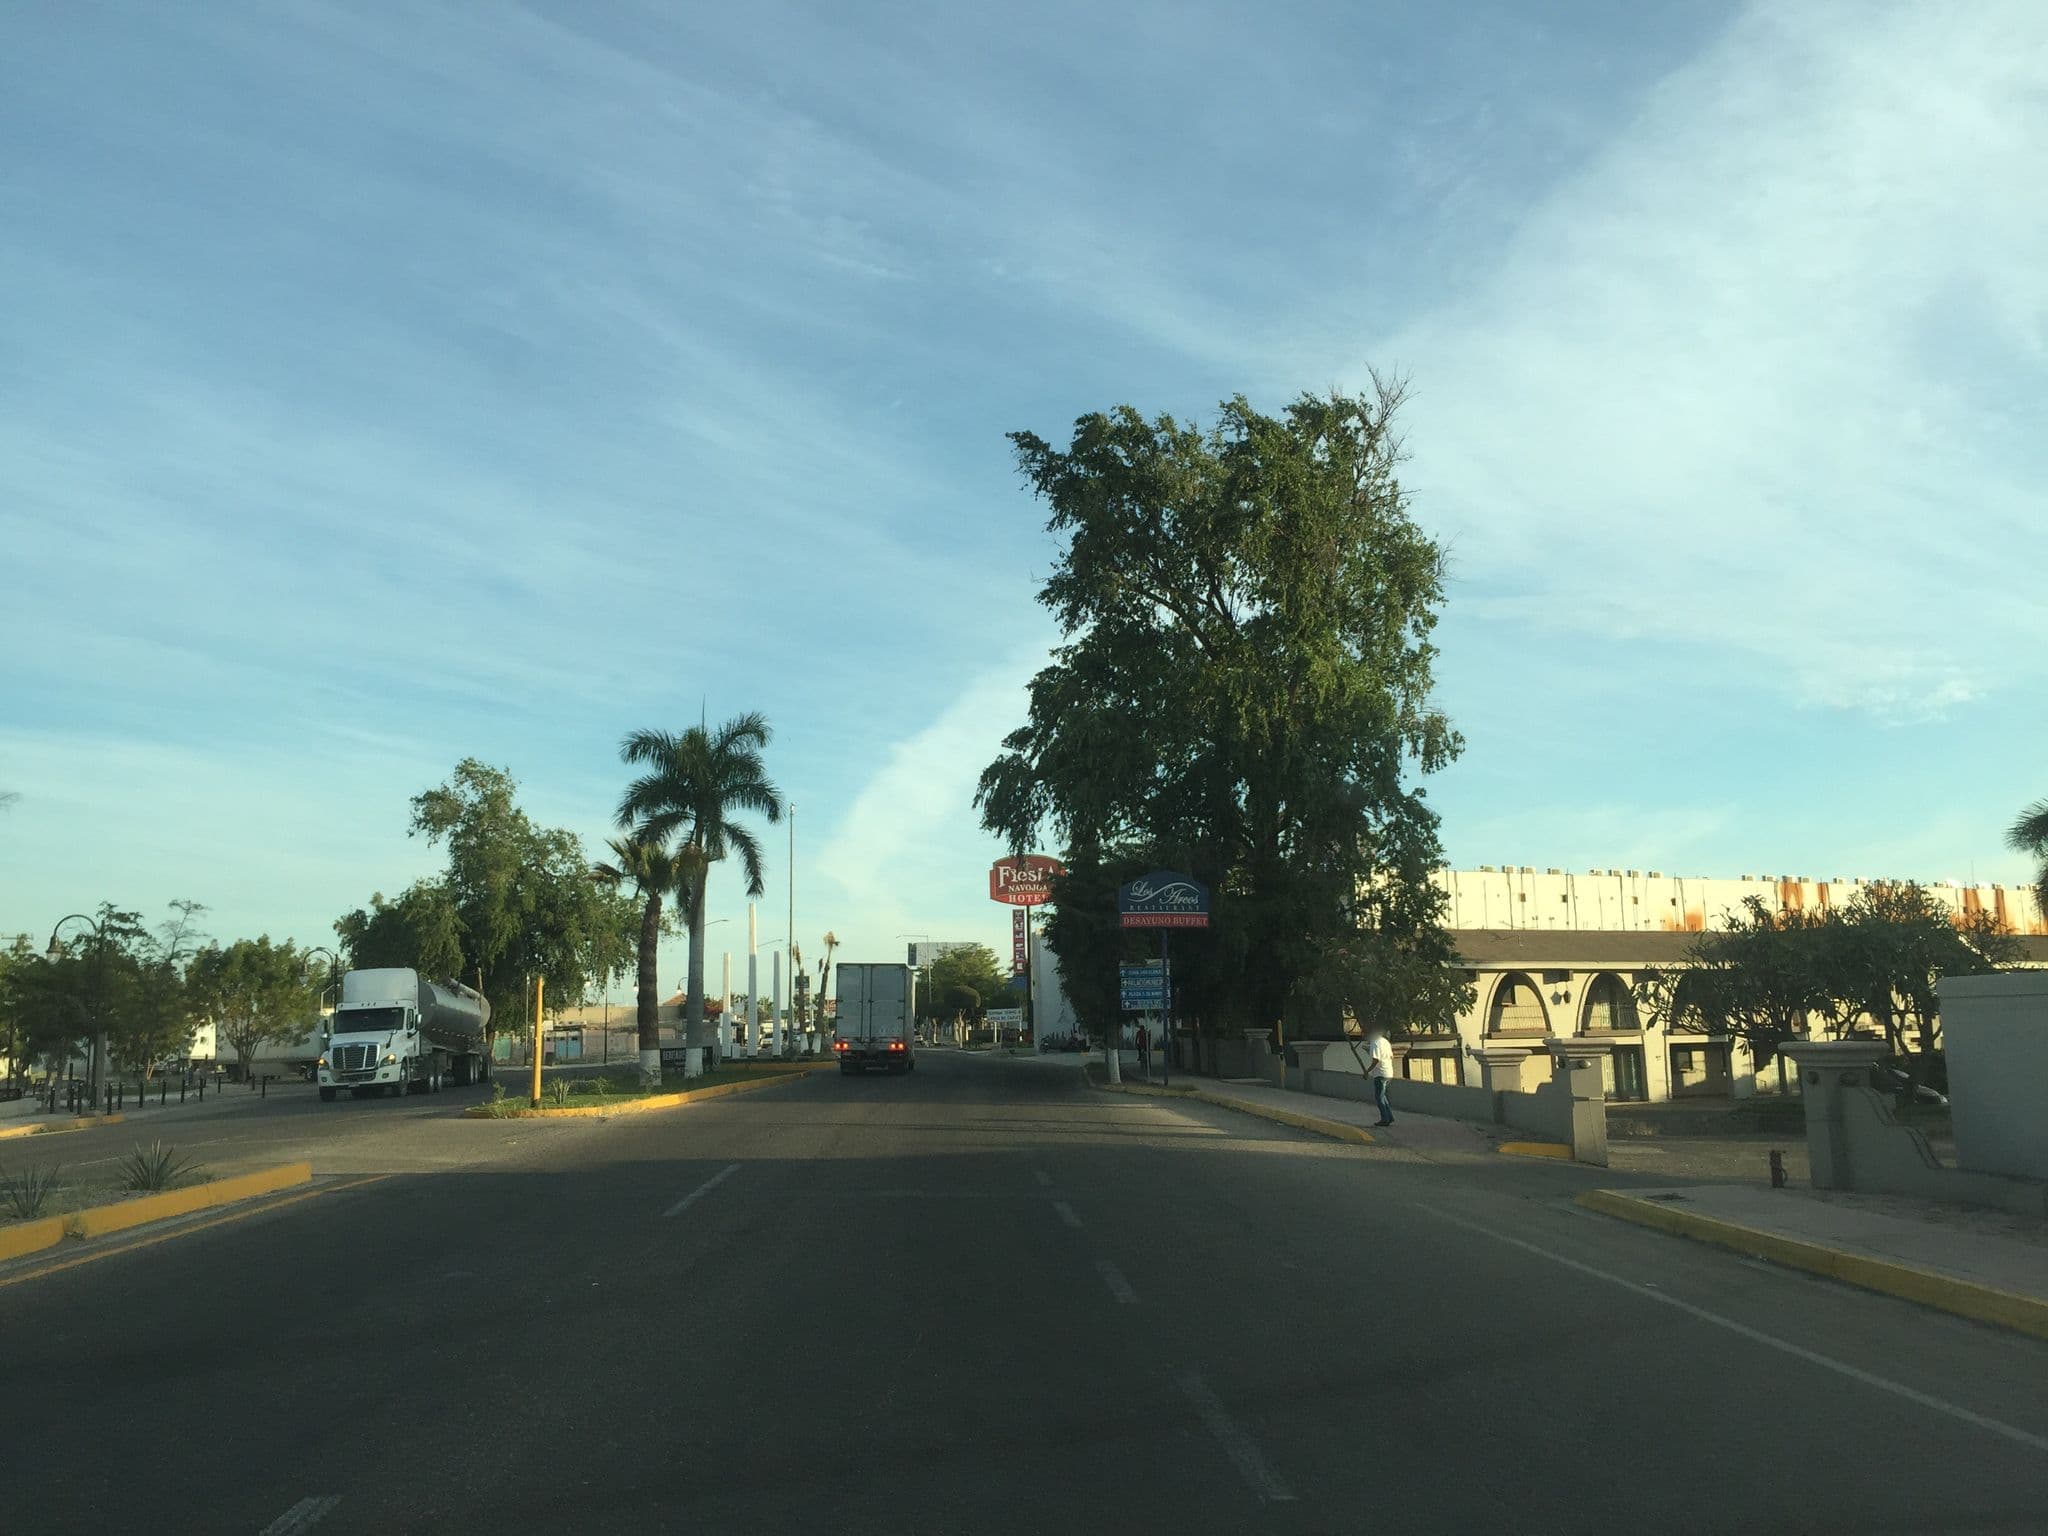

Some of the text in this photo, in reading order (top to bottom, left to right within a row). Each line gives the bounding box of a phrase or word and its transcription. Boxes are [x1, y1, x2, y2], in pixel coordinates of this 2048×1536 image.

[1130, 881, 1200, 904] Los Arcos
[1122, 916, 1207, 926] DESAYUNO BUFFET
